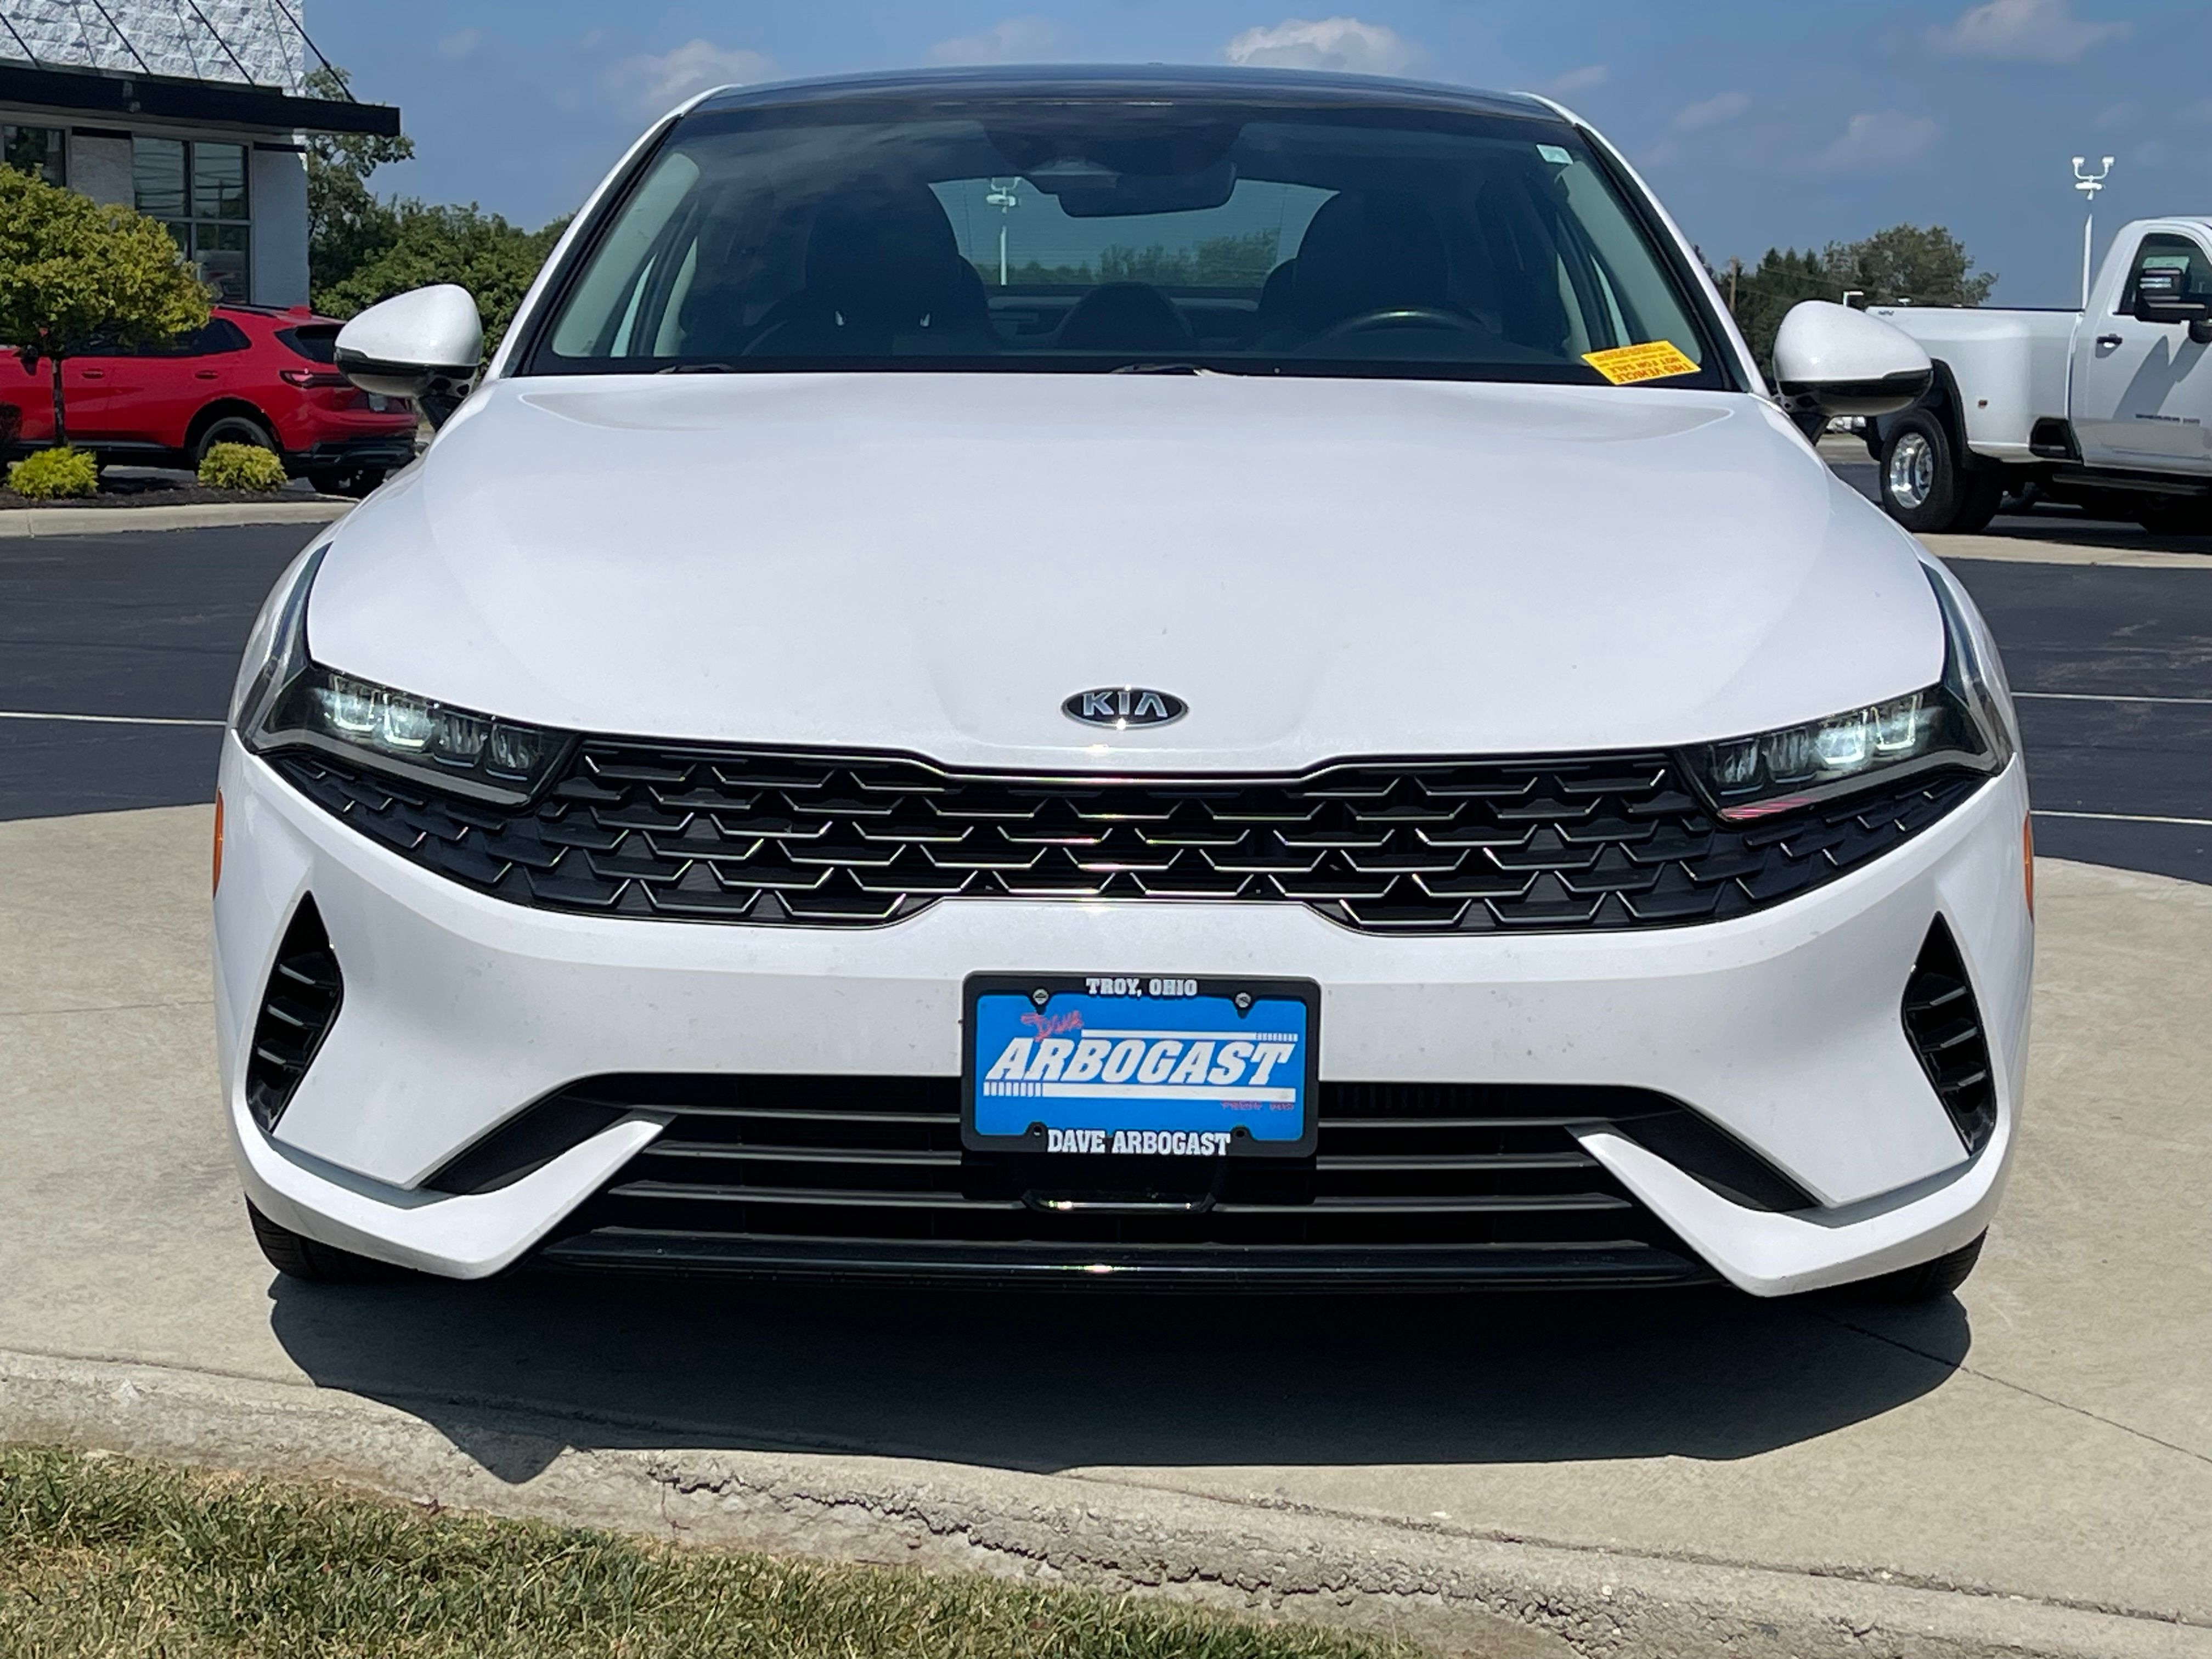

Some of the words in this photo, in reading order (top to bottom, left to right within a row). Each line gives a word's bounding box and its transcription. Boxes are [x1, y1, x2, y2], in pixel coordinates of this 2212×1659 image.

[1082, 691, 1167, 717] KIA
[1086, 978, 1142, 997] TROY,
[1149, 979, 1198, 996] OHIO
[985, 1037, 1296, 1086] ARBOGAST
[1047, 1130, 1105, 1154] DAVE
[1112, 1131, 1231, 1156] ARBOGAST
